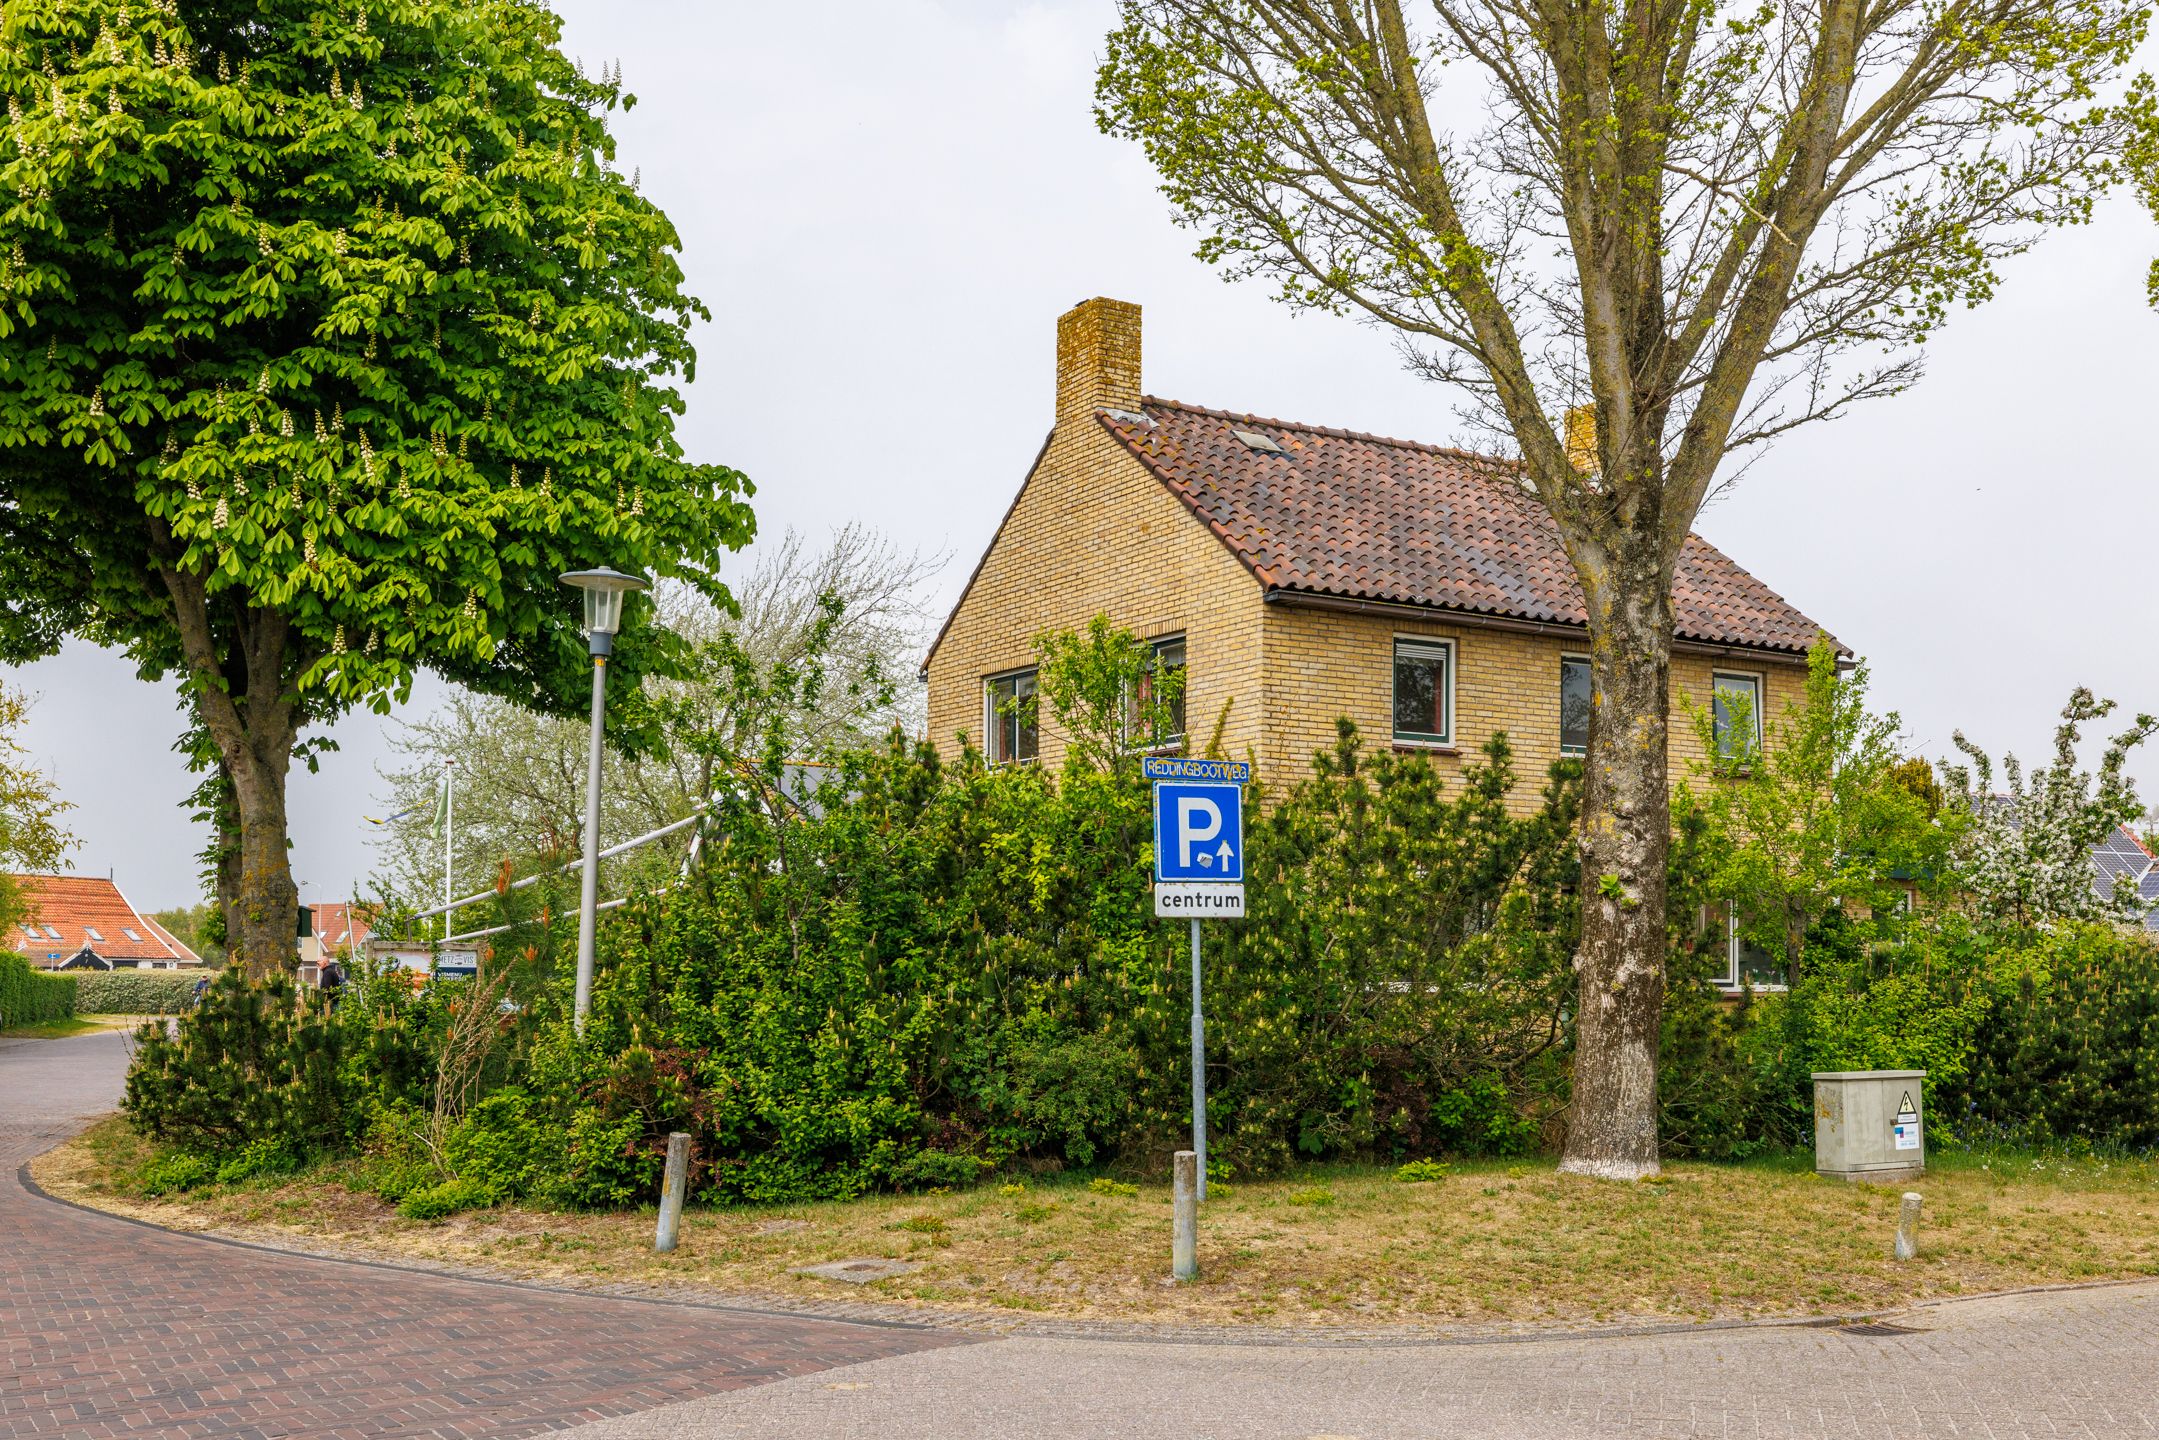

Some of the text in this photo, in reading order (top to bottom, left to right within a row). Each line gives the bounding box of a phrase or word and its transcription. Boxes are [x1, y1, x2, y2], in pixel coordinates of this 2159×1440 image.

[1147, 760, 1247, 779] REDDINGBOOTWEG
[1177, 797, 1223, 868] P
[1162, 892, 1240, 908] centrum
[463, 955, 474, 964] VIS
